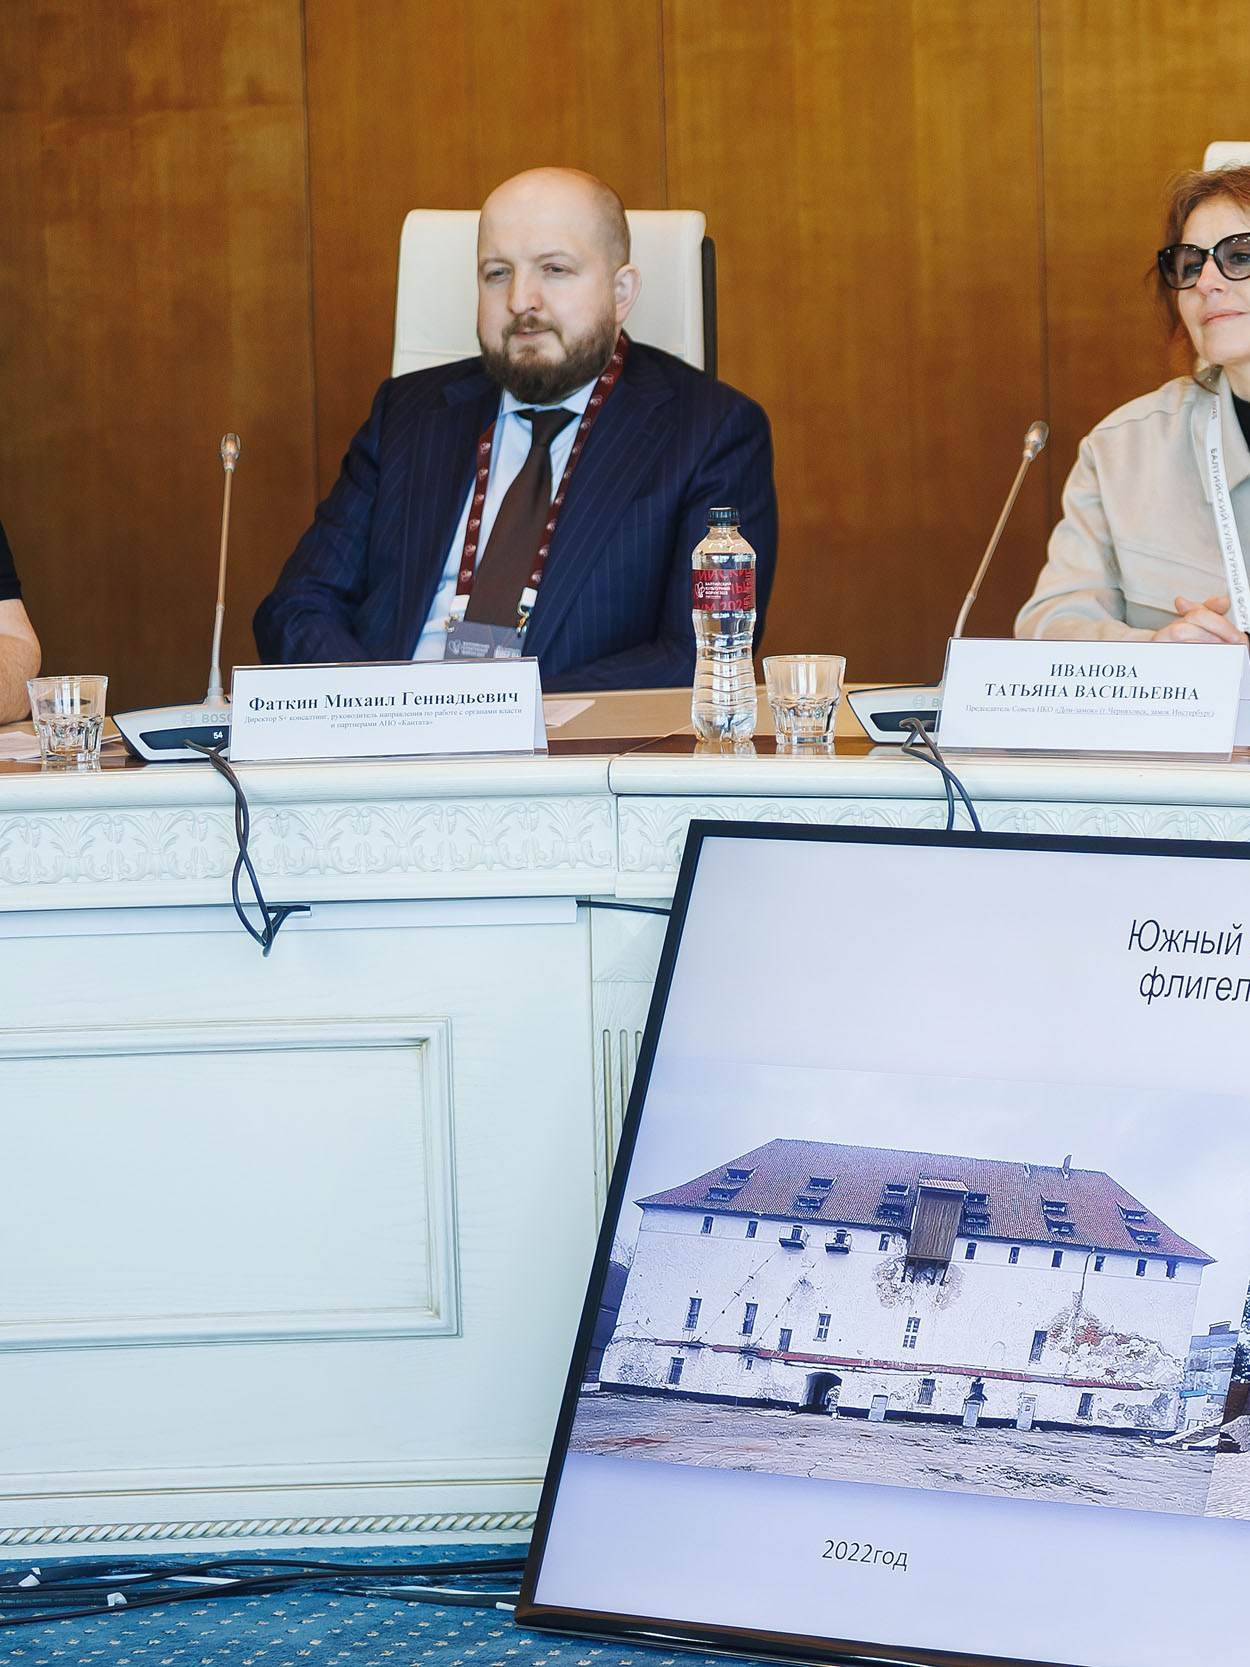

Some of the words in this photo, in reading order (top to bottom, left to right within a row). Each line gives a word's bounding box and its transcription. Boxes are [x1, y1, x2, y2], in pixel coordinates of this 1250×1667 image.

[1050, 663, 1138, 678] ИВАНОВА
[984, 683, 1068, 697] ТАТЬЯНА
[1074, 684, 1199, 700] ВАСИЛЬЕВНА
[249, 697, 318, 711] Фаткин
[324, 694, 395, 708] Михаил
[401, 691, 519, 706] Геннадьевич
[244, 715, 277, 724] Директор
[213, 731, 224, 740] 54
[1127, 919, 1243, 957] Южный
[821, 1539, 908, 1572] 2022год
